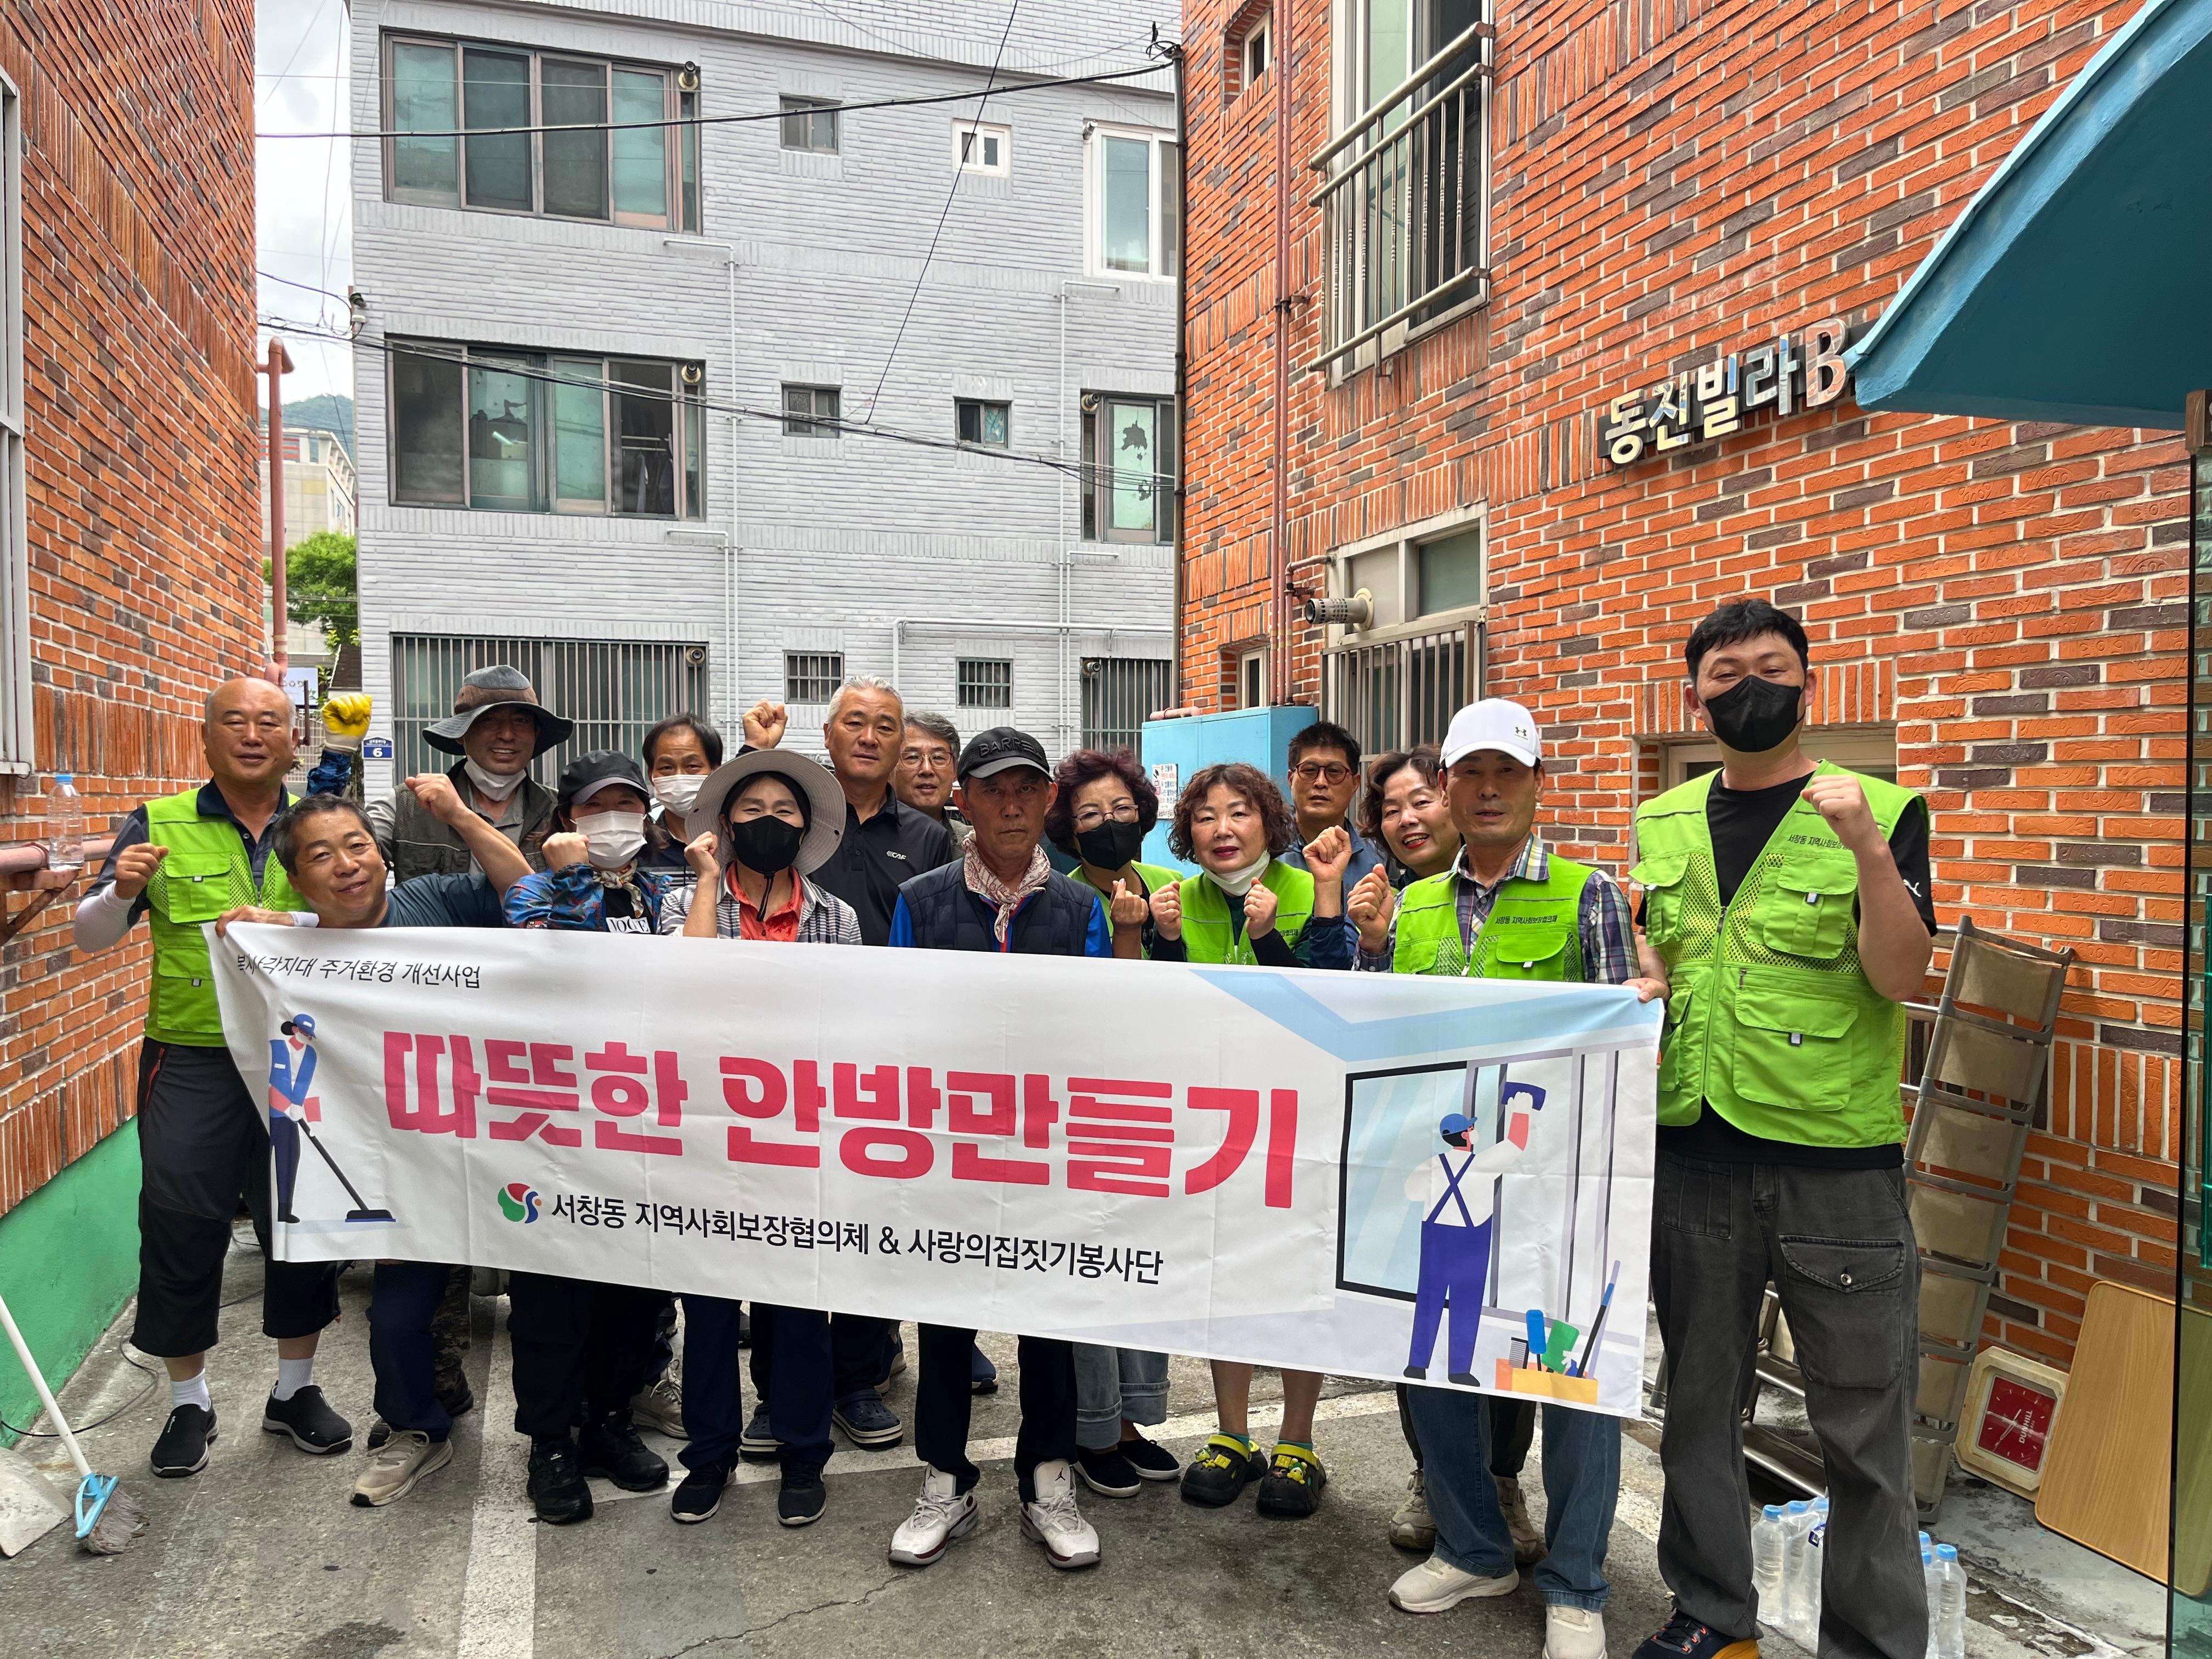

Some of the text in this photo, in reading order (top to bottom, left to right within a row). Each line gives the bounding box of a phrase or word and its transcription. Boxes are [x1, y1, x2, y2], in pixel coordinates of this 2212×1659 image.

[373, 748, 383, 757] 6
[979, 737, 1042, 759] BARREL
[1787, 834, 1808, 845] 서창동
[319, 959, 398, 983] 주거환경
[402, 963, 481, 989] 개선사업
[383, 1031, 1299, 1209] 따뜻한 안방만들기
[551, 1193, 1164, 1285] 서창동 지역사회보장협의체 & 사랑의집짓기봉사단
[2019, 1410, 2033, 1444] DUNHILL
